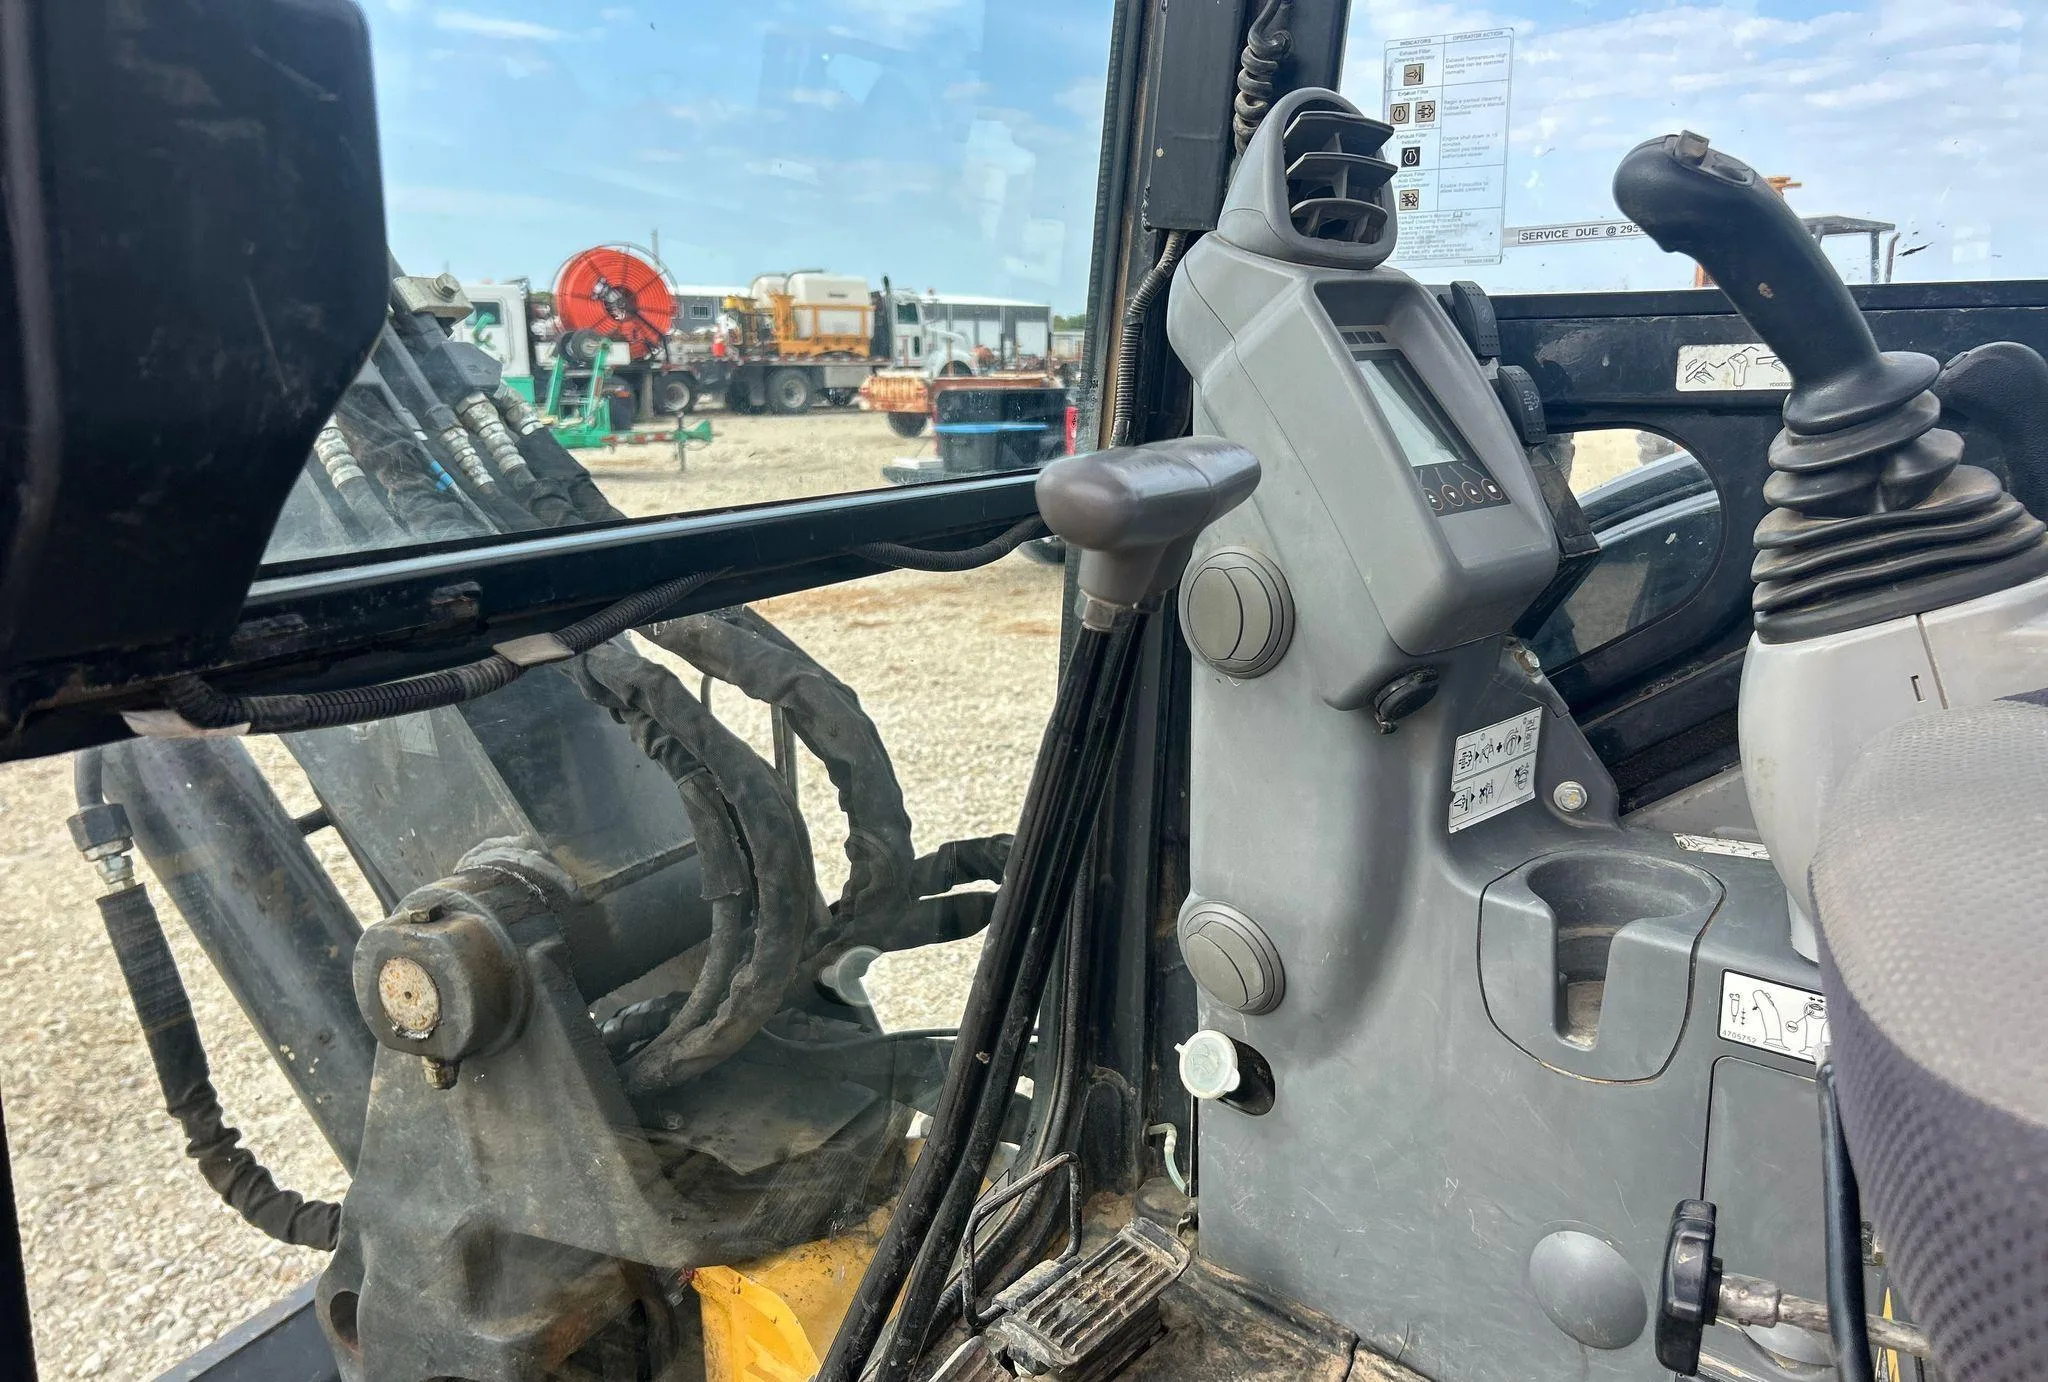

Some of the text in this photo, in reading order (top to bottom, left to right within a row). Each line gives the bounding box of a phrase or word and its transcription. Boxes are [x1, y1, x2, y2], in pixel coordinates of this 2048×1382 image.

[1521, 229, 1569, 241] SERVICE
[1575, 227, 1599, 237] DUE
[1605, 225, 1617, 237] @
[1722, 1030, 1757, 1044] 4705752
